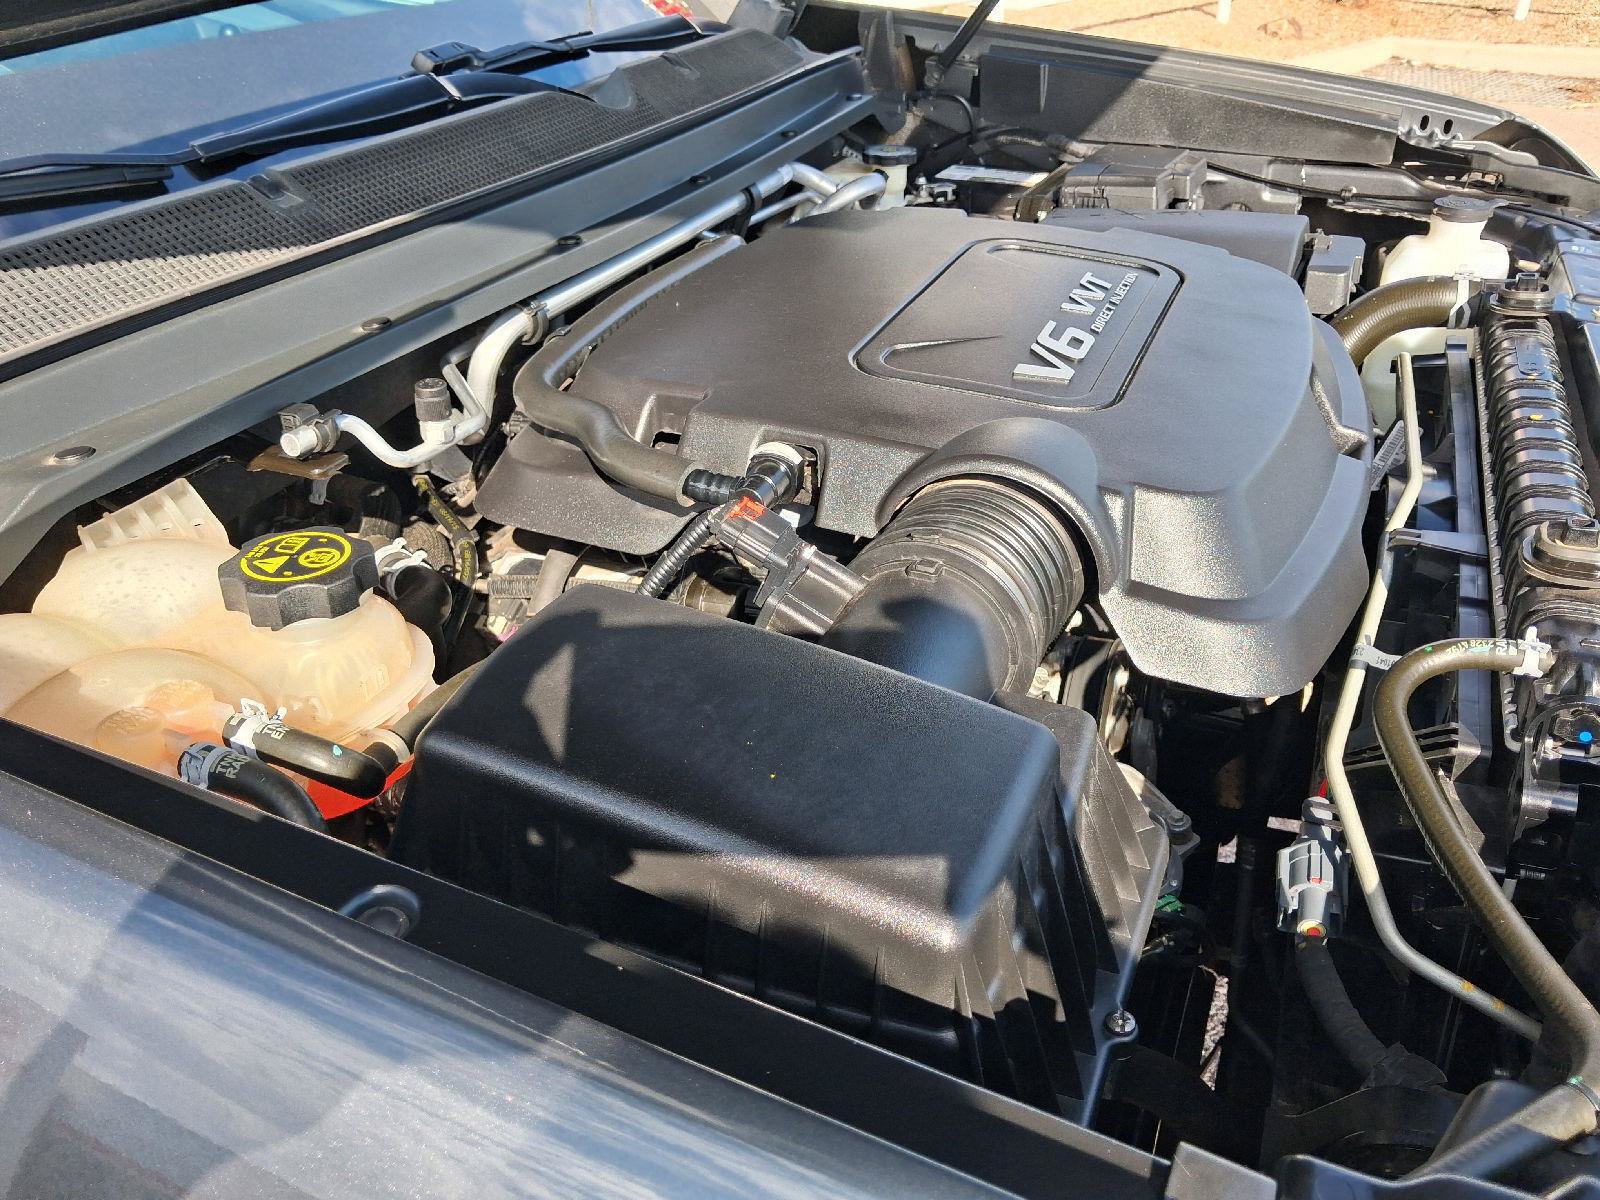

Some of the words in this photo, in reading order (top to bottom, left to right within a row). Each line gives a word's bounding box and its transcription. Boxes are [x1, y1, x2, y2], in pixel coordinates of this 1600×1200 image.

[1012, 320, 1095, 384] V6
[1060, 271, 1113, 315] VVT
[1091, 303, 1116, 333] DIRECT
[1109, 272, 1139, 305] INJECTION
